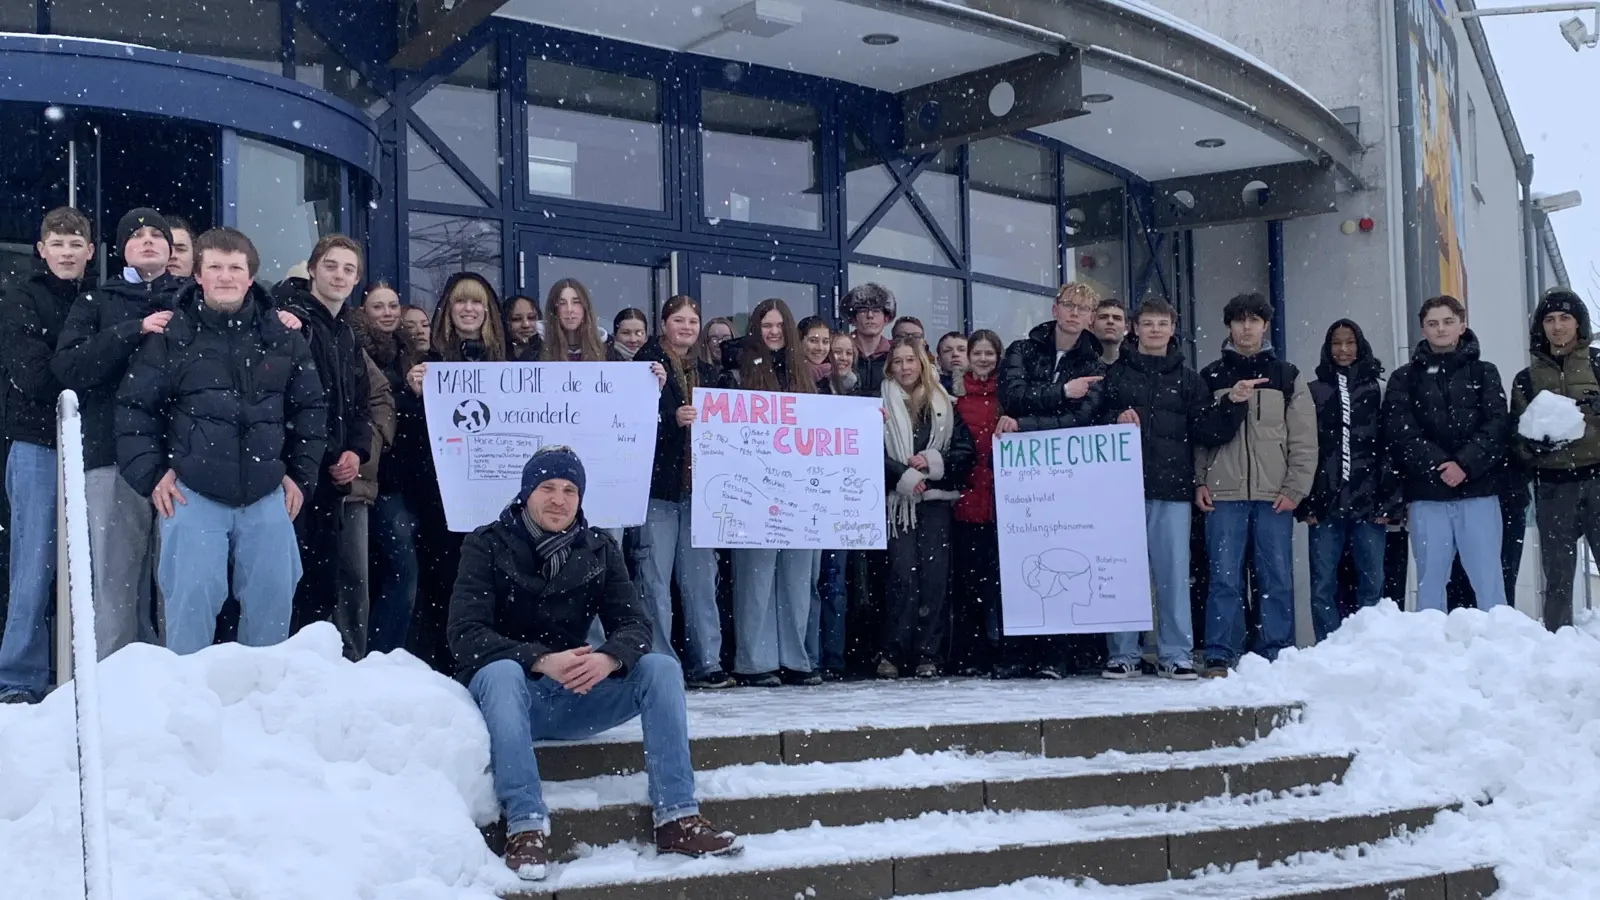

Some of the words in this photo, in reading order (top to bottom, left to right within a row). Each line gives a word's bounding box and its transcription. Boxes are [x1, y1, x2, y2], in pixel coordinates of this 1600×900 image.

[438, 368, 487, 394] MARIE
[500, 367, 546, 394] CURIE
[562, 370, 583, 394] die
[595, 370, 613, 394] die
[498, 402, 581, 425] veränderte
[701, 391, 797, 425] MARIE
[773, 427, 860, 457] CURIE
[1000, 437, 1063, 468] MARIE
[1067, 431, 1132, 466] CURIE
[1000, 468, 1013, 477] Der
[1025, 507, 1032, 518] &
